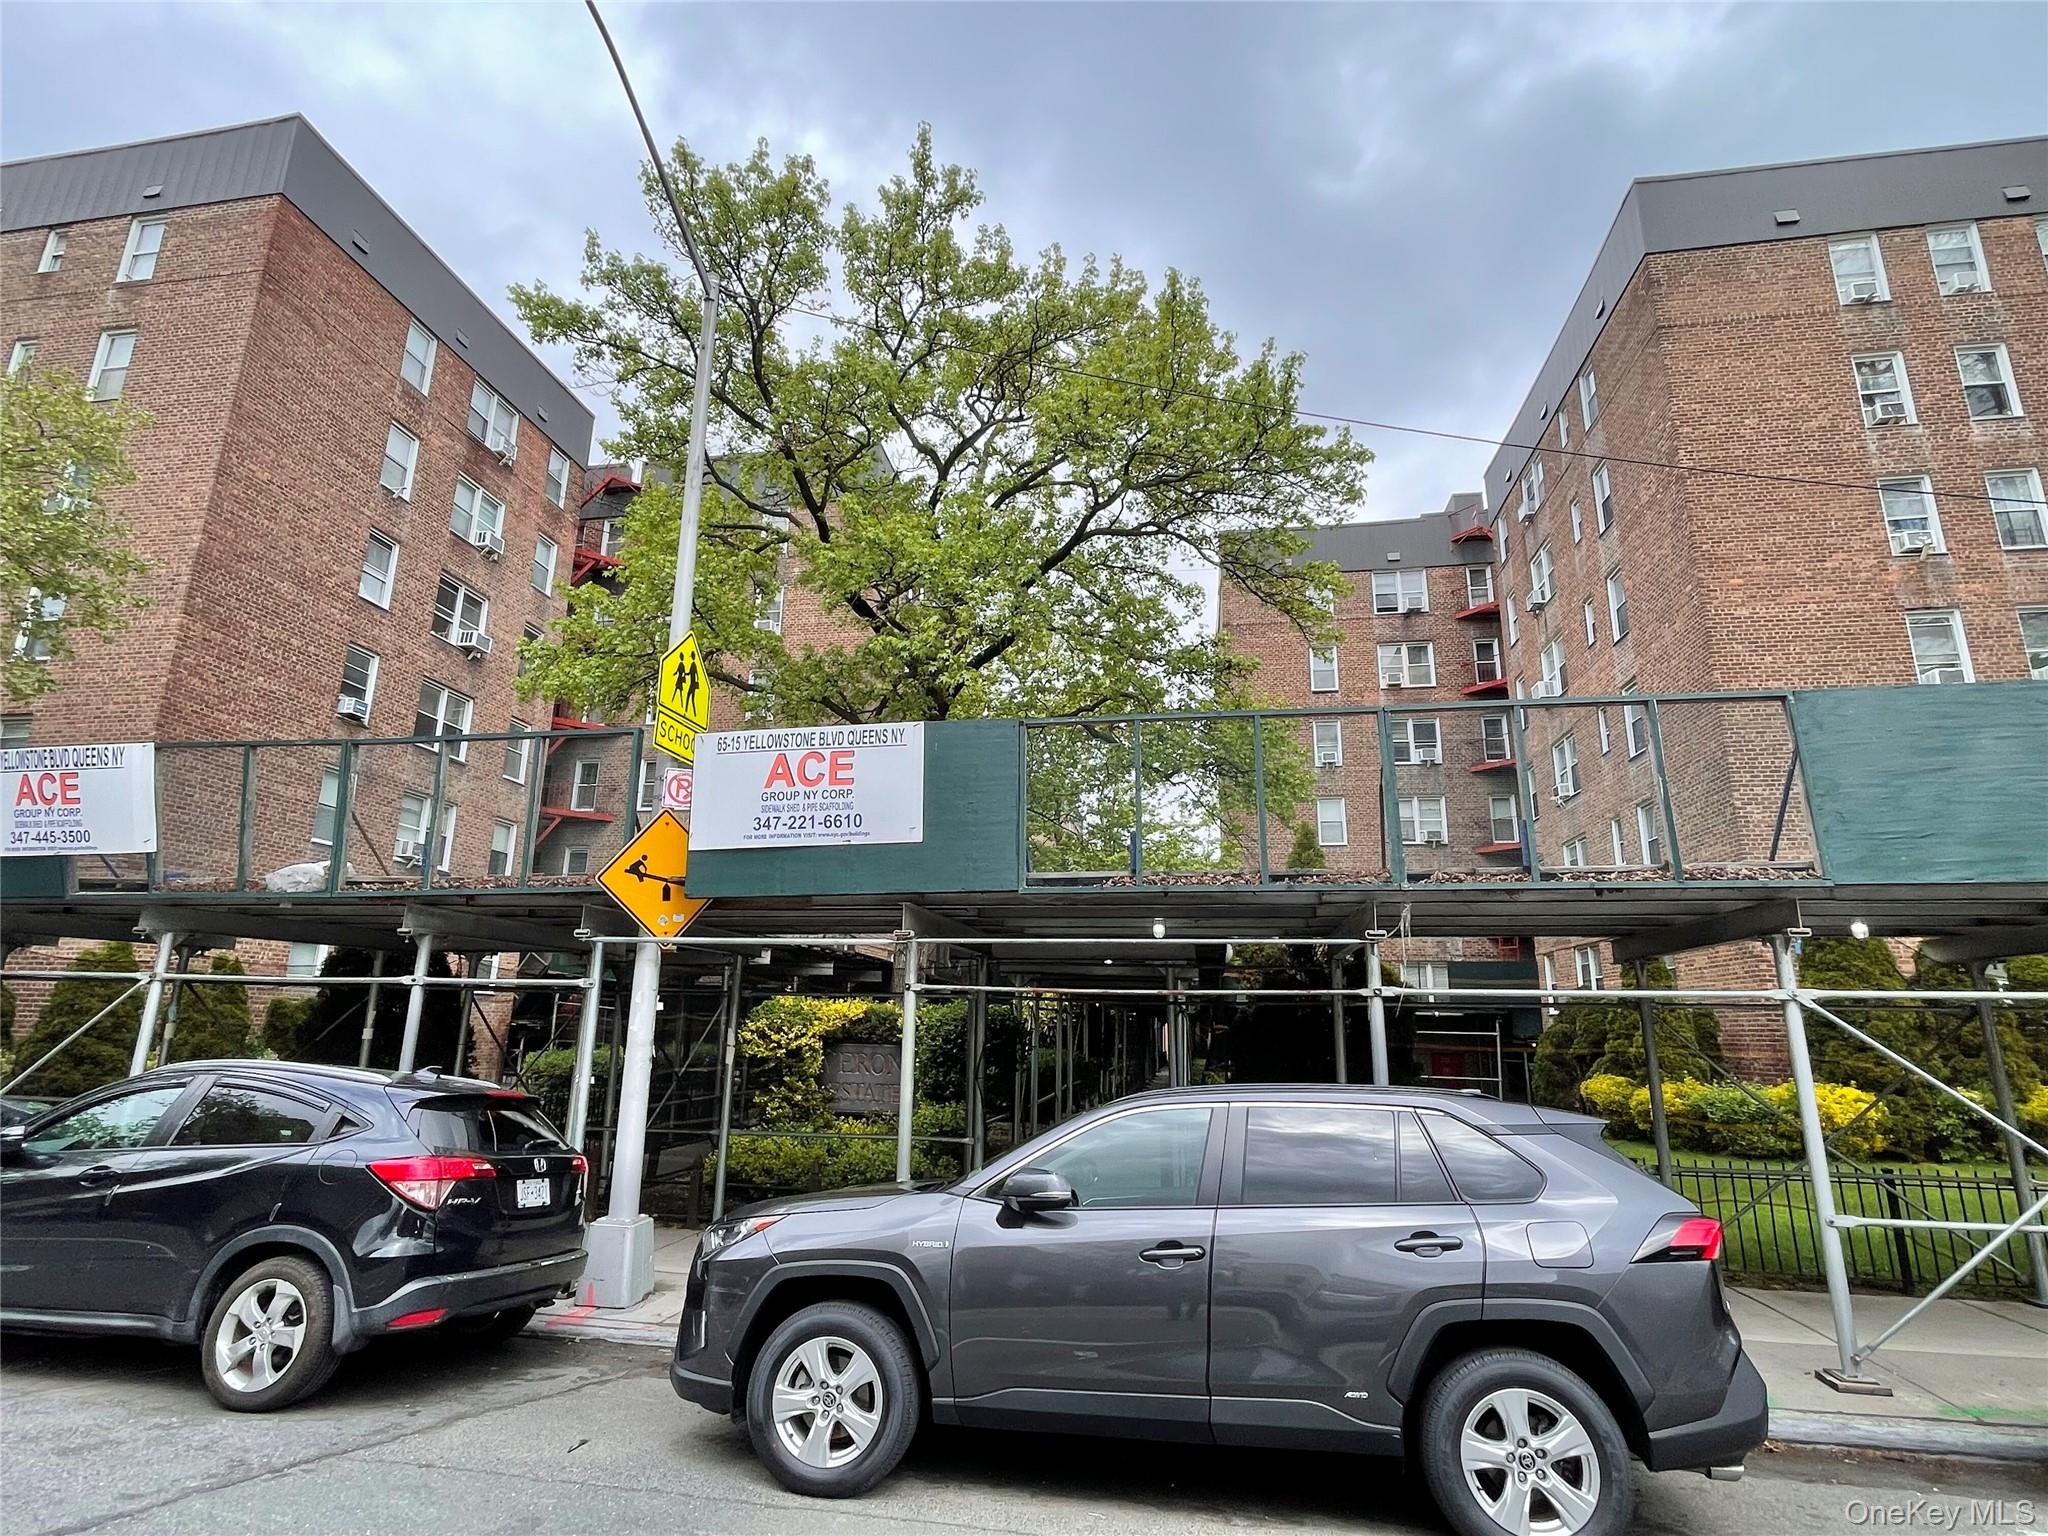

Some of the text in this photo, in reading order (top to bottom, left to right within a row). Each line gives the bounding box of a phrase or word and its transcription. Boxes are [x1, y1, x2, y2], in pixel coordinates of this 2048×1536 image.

[717, 728, 905, 752] 65-15 YELLOWSTONE BLVD QUEENS NY
[49, 748, 70, 768] BLVD
[72, 746, 109, 767] QUEENS
[112, 746, 125, 766] NY
[764, 750, 855, 789] ACE
[15, 771, 81, 807] ACE
[761, 788, 855, 802] GROUP NY CORP.
[13, 807, 83, 818] GROUP NY CORP.
[760, 803, 786, 813] SIDEWALK
[786, 803, 800, 813] SHED
[806, 803, 818, 812] PIPE
[819, 801, 854, 812] SCAFFOLDING
[753, 813, 863, 831] 347-221-6610
[10, 829, 91, 844] 347-445-3500
[911, 1240, 943, 1248] HYBRID
